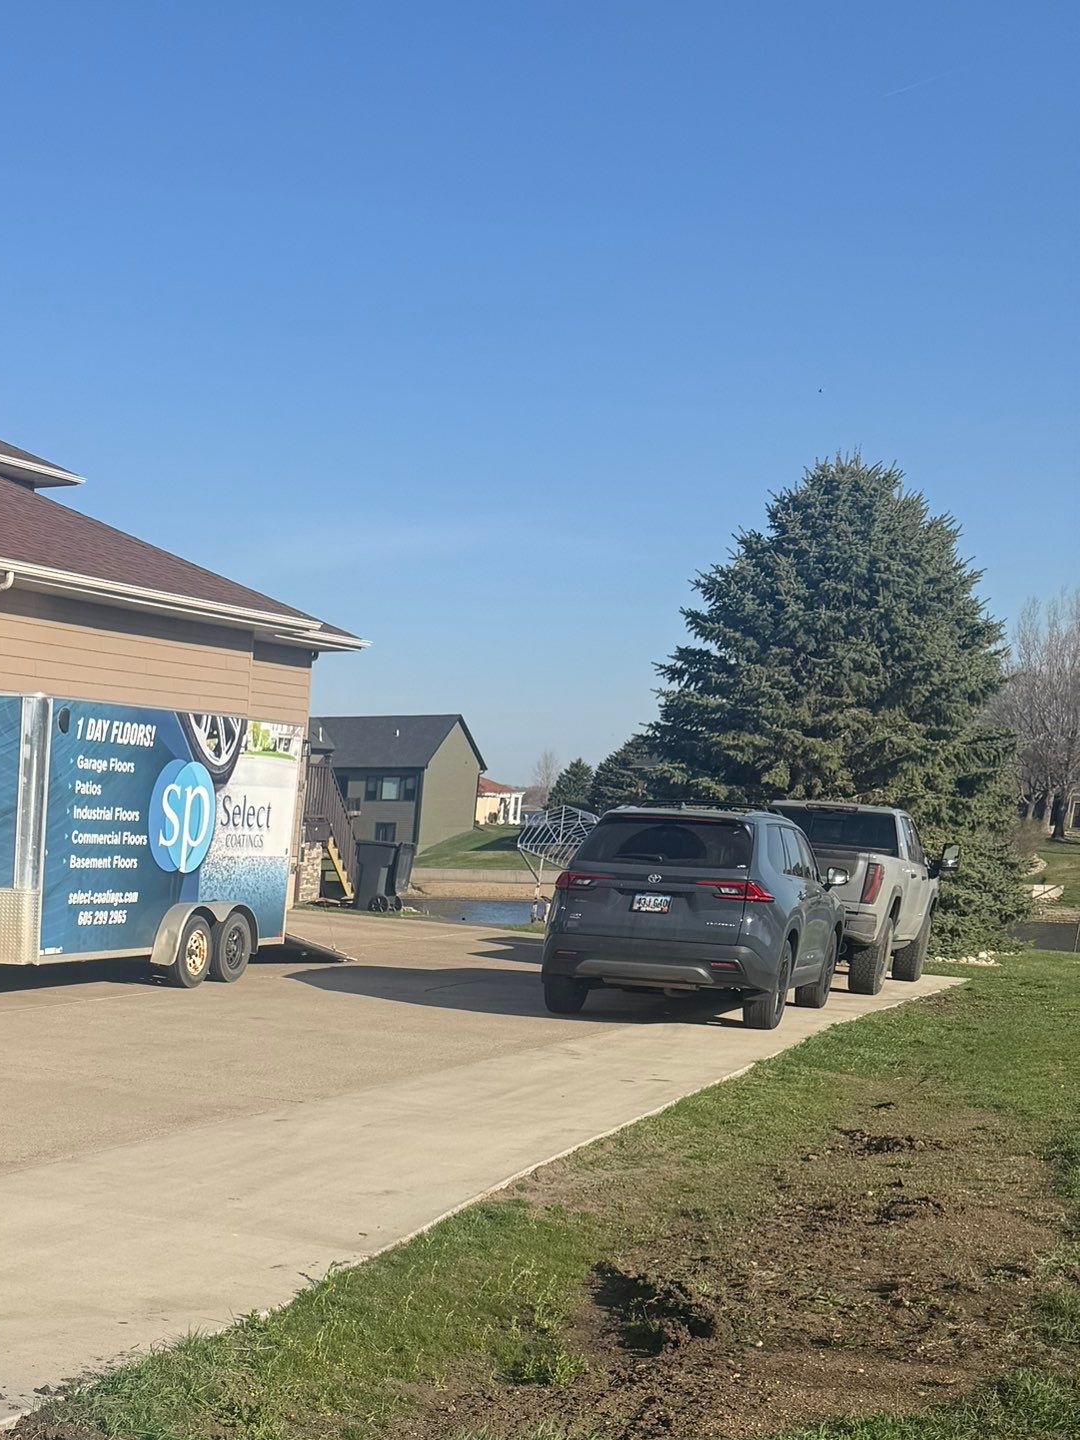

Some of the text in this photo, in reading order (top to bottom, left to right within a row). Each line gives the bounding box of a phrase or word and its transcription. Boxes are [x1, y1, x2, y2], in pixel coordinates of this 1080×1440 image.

[77, 717, 157, 747] 1 DAY FLOORS!
[77, 754, 135, 773] Garage Floors
[75, 780, 102, 796] Patios
[73, 805, 140, 822] Industrial Floors
[221, 795, 271, 829] Select
[159, 784, 210, 873] sp
[72, 830, 148, 846] Commercial Floors
[225, 834, 264, 848] COATINGS
[70, 855, 138, 869] Basement Floors
[68, 889, 139, 906] select-coatings.com
[78, 910, 127, 926] 605 299 2965
